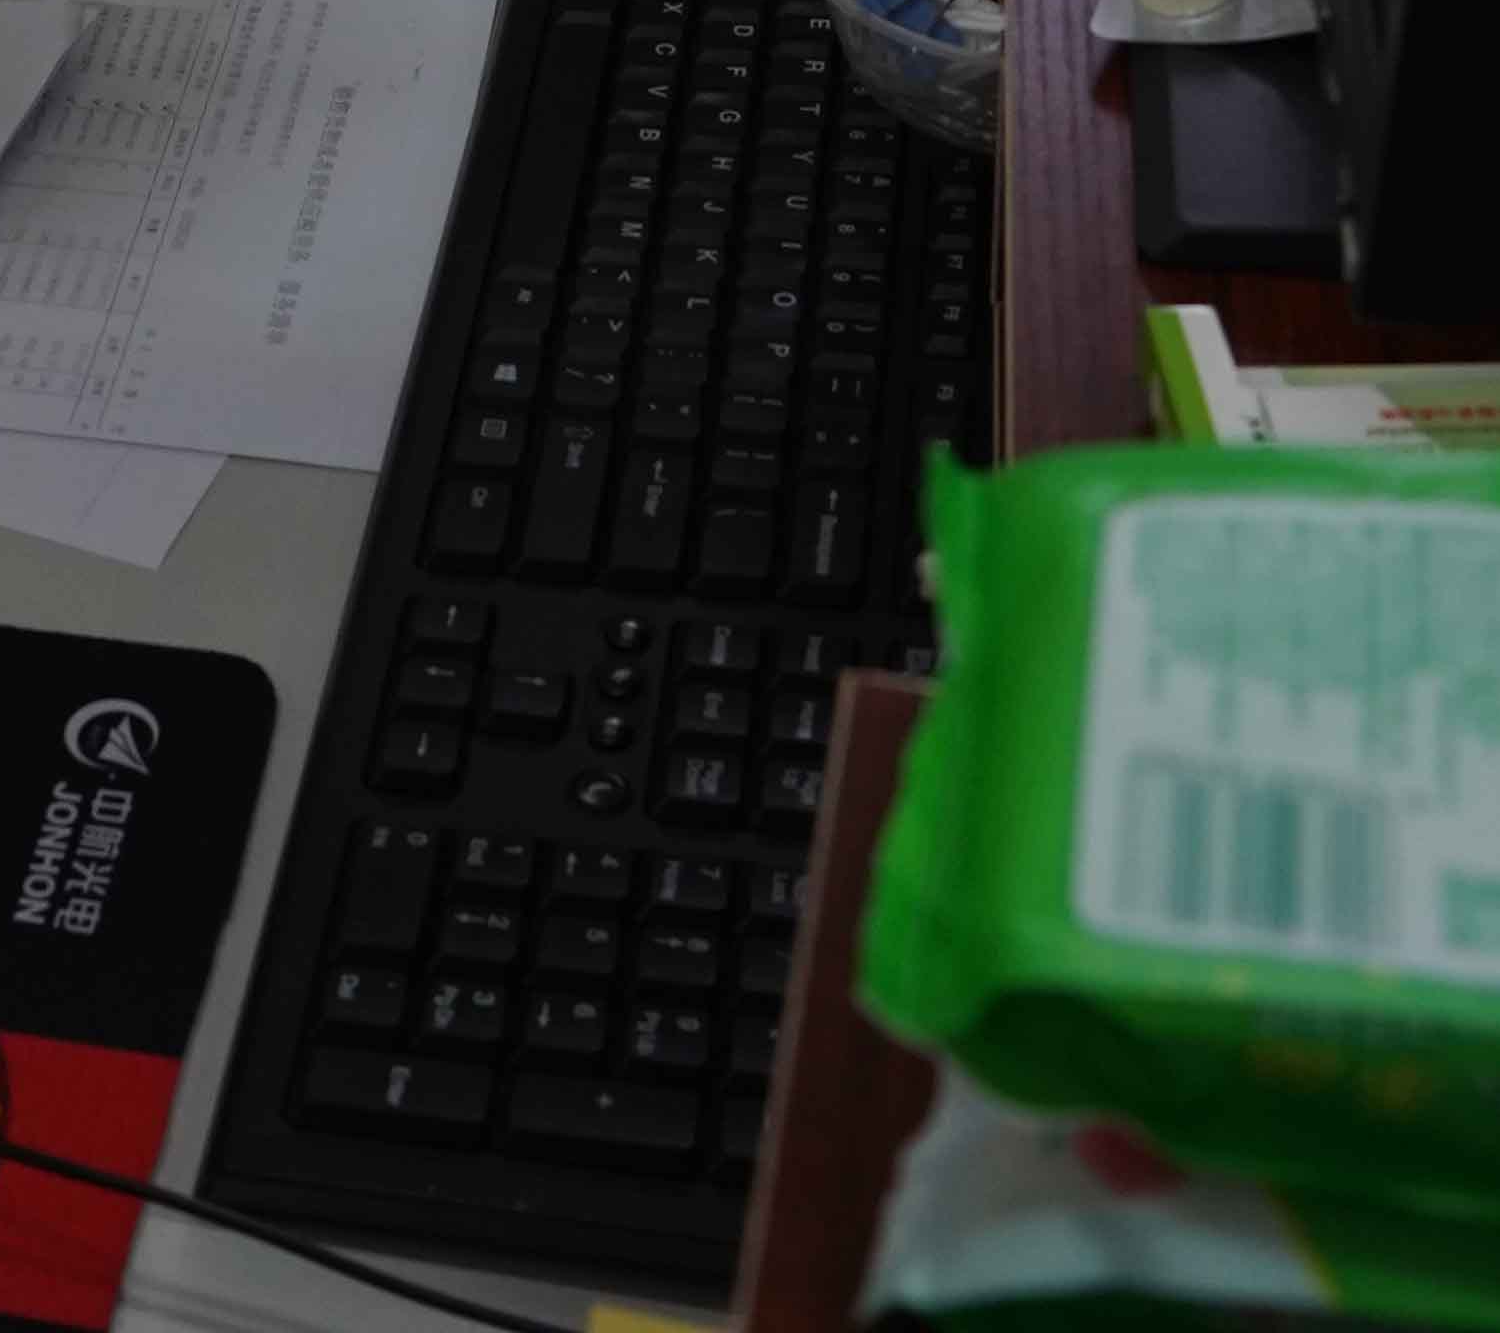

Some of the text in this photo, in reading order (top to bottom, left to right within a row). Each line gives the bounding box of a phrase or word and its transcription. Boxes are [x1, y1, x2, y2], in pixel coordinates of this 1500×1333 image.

[663, 2, 683, 14] X
[809, 18, 831, 29] E
[733, 24, 755, 37] D
[655, 43, 677, 55] C
[727, 66, 747, 77] F
[804, 60, 826, 73] R
[647, 85, 669, 98] V
[799, 103, 821, 116] T
[719, 110, 742, 123] G
[639, 128, 661, 141] B
[713, 157, 732, 170] H
[792, 150, 814, 164] Y
[629, 176, 652, 189] N
[703, 201, 725, 213] J
[785, 195, 808, 209] U
[621, 221, 643, 238] M
[697, 249, 717, 262] K
[832, 272, 851, 282] 9
[686, 297, 710, 309] L
[772, 291, 797, 308] O
[768, 343, 791, 358] P
[13, 781, 83, 925] JONHON
[53, 788, 133, 935] 中航光电
